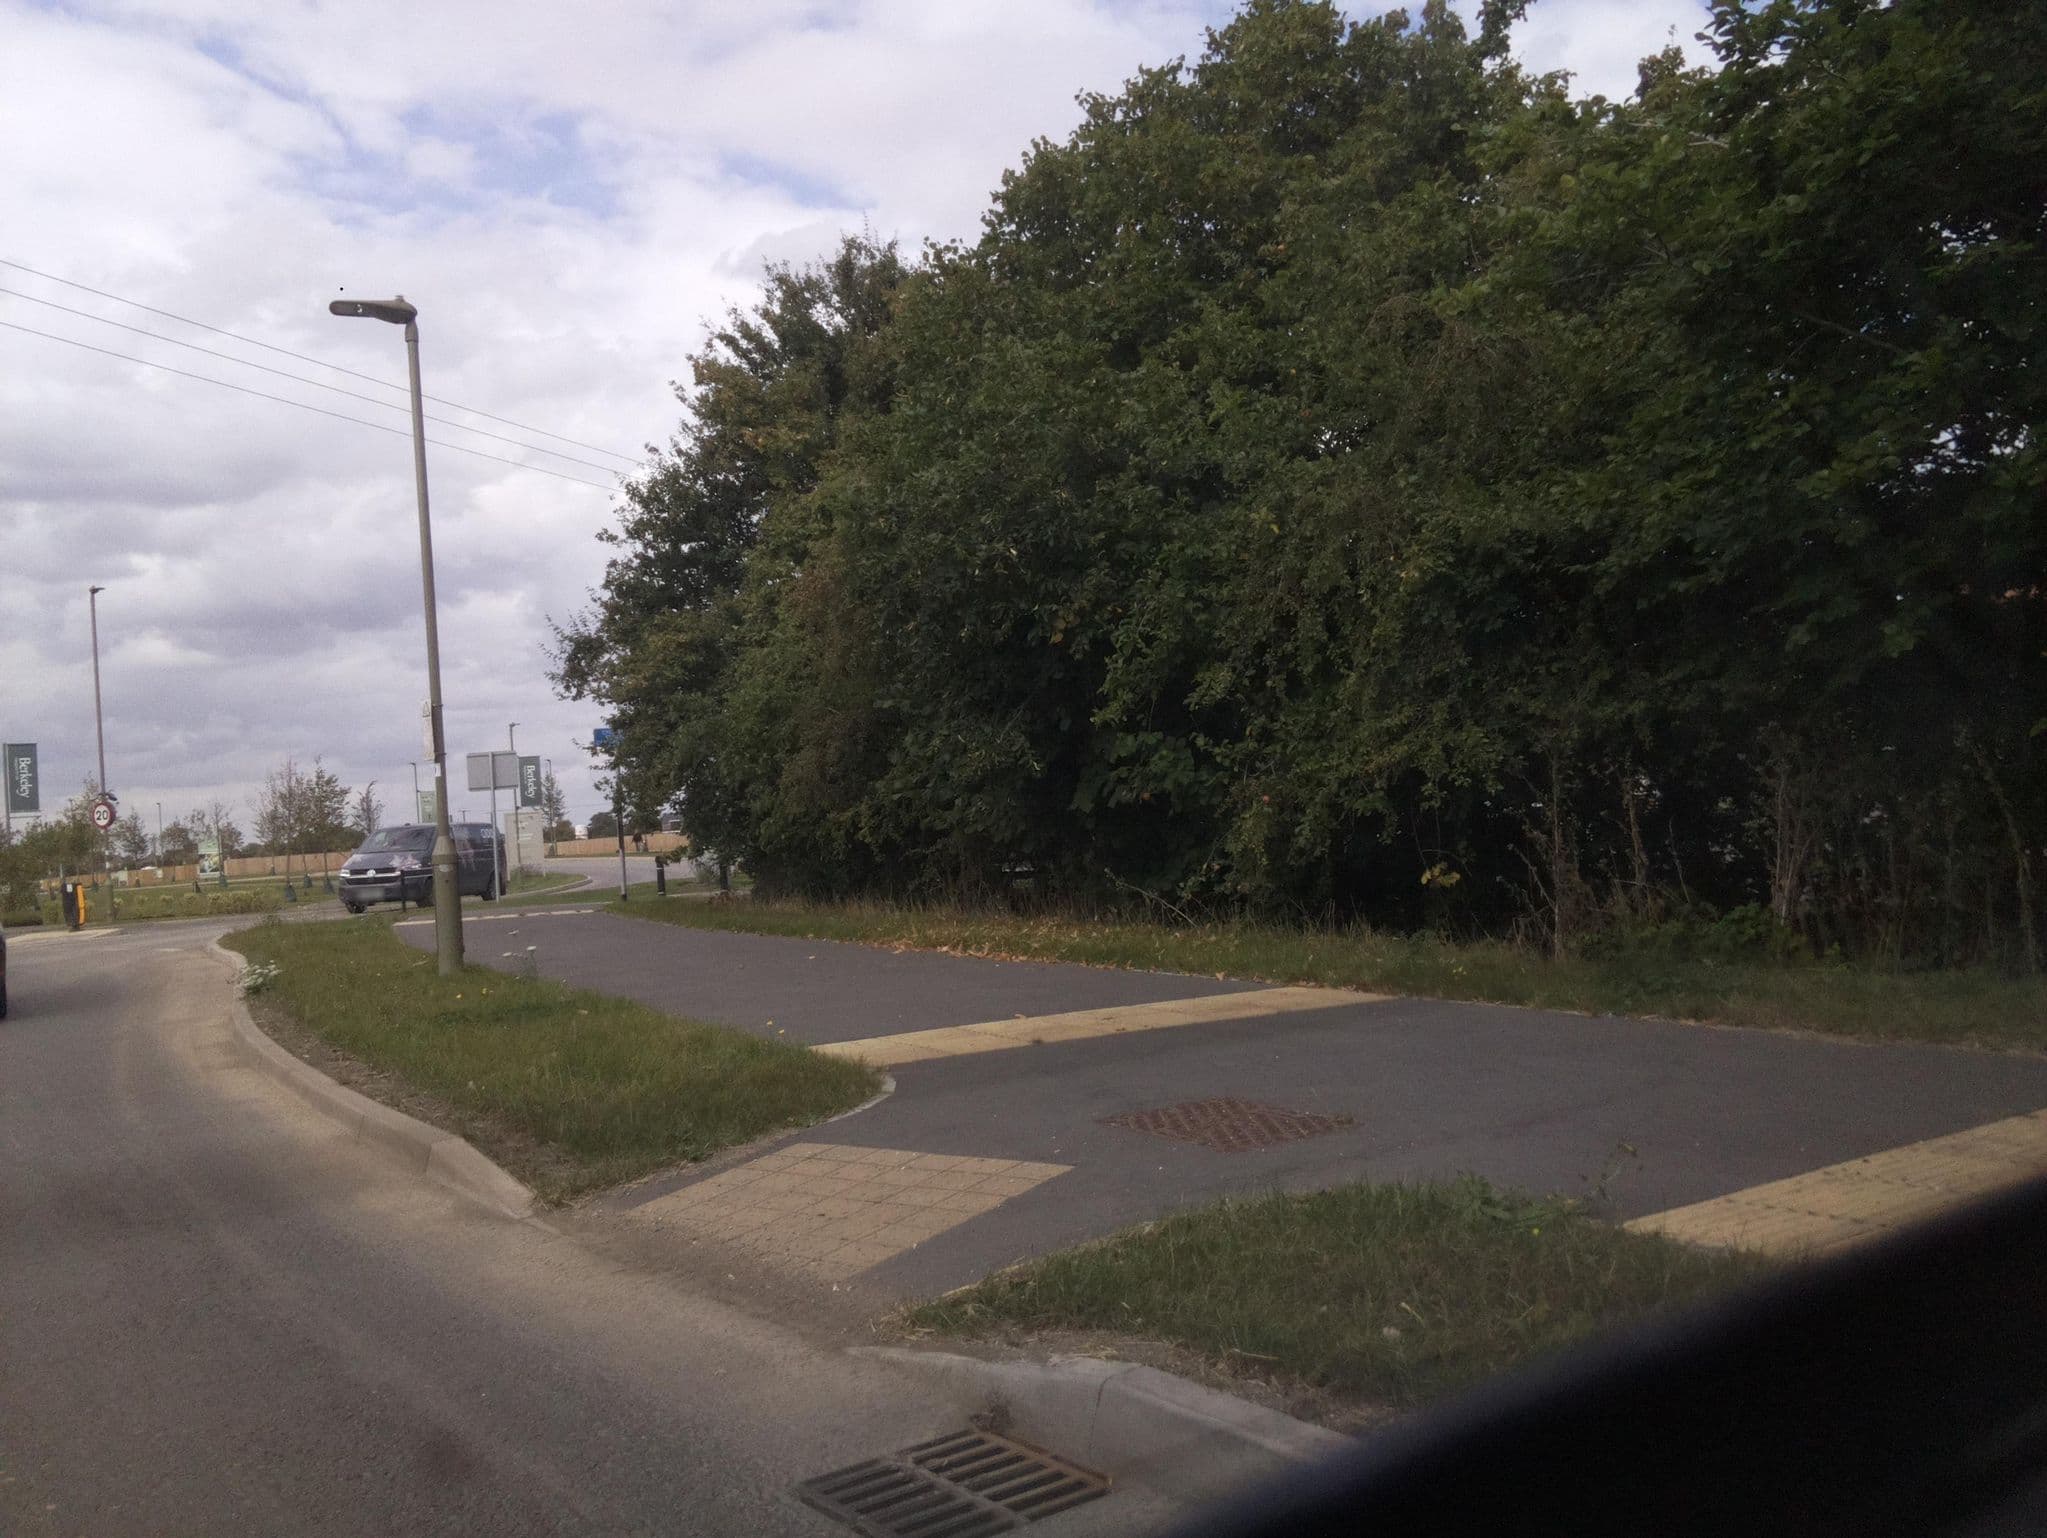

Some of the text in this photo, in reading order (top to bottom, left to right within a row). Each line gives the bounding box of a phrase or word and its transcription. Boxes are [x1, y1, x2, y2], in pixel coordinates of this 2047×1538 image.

[16, 757, 33, 798] Berkeley
[525, 765, 537, 799] Berkeley
[96, 810, 108, 821] 20
